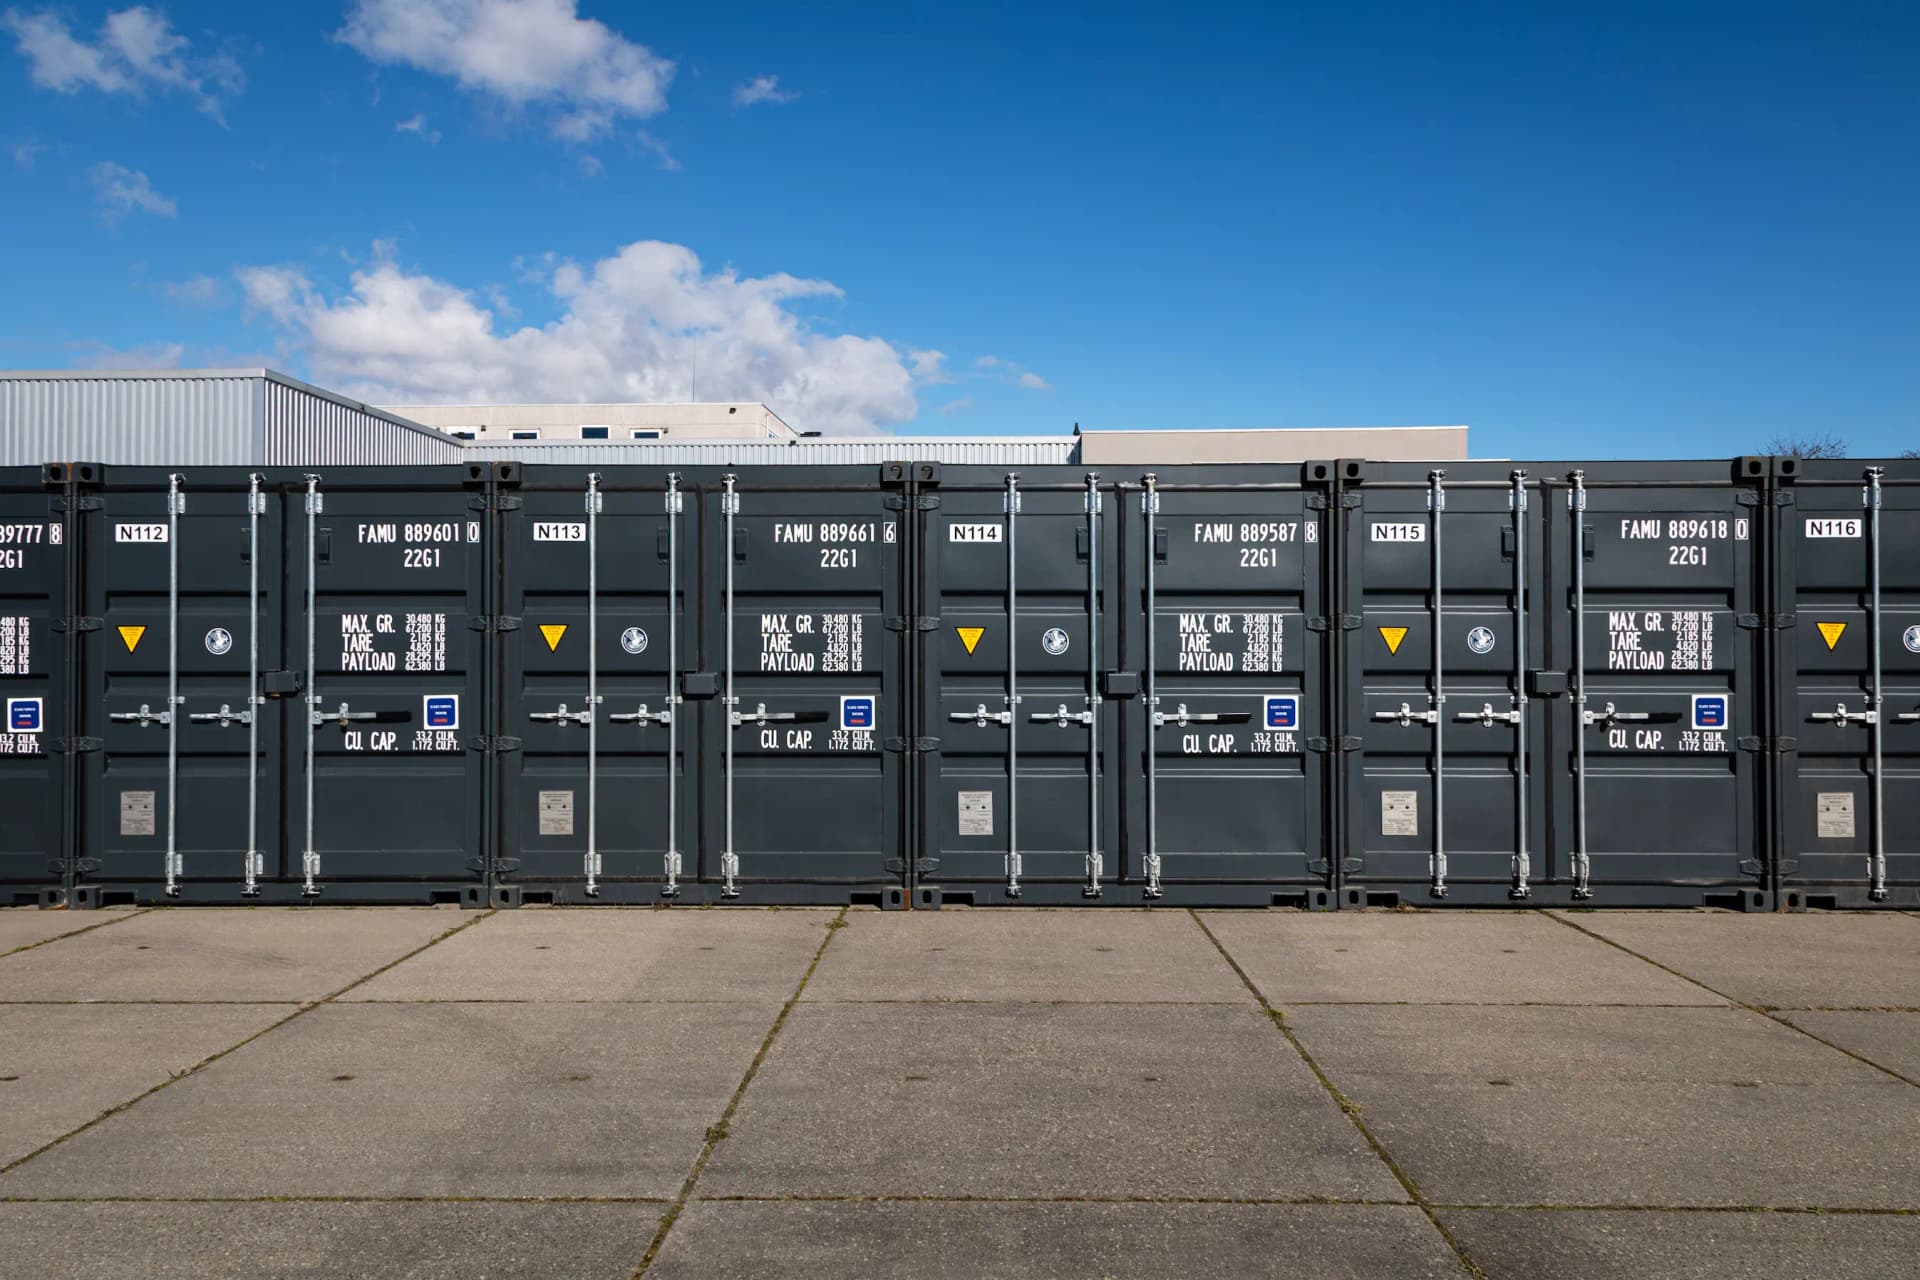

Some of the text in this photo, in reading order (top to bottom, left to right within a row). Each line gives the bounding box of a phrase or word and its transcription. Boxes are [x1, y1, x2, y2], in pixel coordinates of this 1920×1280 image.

[121, 526, 162, 540] N112
[539, 525, 580, 539] N113
[775, 523, 894, 542] FAMU 889661 6
[954, 526, 996, 540] N114
[1194, 523, 1315, 542] FAMU 889587 8
[1376, 525, 1419, 539] N115
[1621, 520, 1746, 539] FAMU 889618 0
[1811, 521, 1855, 535] N116
[52, 525, 60, 543] 8
[358, 524, 478, 543] FAMU 889601 0
[404, 549, 440, 567] 22G1
[821, 549, 856, 567] 22G1
[1240, 548, 1276, 567] 22G1
[1670, 546, 1706, 565] 22G1
[19, 617, 29, 626] KG
[405, 614, 445, 623] 30.480 KG
[822, 615, 862, 623] 30.480 KG
[1242, 615, 1283, 623] 30.480 KG
[1609, 612, 1664, 631] MAX. GR.
[1672, 612, 1712, 621] 30.480 KG
[342, 615, 395, 633] MAX. GR.
[405, 624, 445, 632] 67.200 LB
[761, 615, 814, 633] MAX. GR.
[822, 624, 862, 633] 67.200 LB
[1179, 614, 1233, 633] MAX. GR.
[1242, 624, 1283, 633] 67.200 LB
[1672, 622, 1712, 631] 67.200 LB
[19, 627, 29, 636] LB
[1702, 632, 1712, 640] KG
[19, 636, 29, 645] KG
[342, 634, 374, 651] TARE
[435, 634, 445, 642] KG
[762, 634, 792, 652] TARE
[852, 634, 862, 642] KG
[1180, 634, 1211, 652] TARE
[1272, 634, 1283, 642] KG
[1609, 632, 1642, 650] TARE
[19, 646, 29, 655] LB
[435, 643, 445, 651] LB
[852, 643, 862, 652] LB
[1272, 644, 1283, 652] LB
[1702, 641, 1712, 650] LB
[19, 655, 29, 664] KG
[435, 652, 445, 661] KG
[852, 653, 862, 661] KG
[1272, 653, 1283, 662] KG
[1609, 651, 1664, 670] PAYLOAD
[1702, 651, 1712, 660] KG
[342, 653, 396, 670] PAYLOAD
[435, 662, 445, 670] LB
[761, 653, 814, 671] PAYLOAD
[1179, 653, 1233, 671] PAYLOAD
[1702, 660, 1712, 670] LB
[19, 665, 29, 674] LB
[852, 663, 862, 671] LB
[1272, 663, 1283, 671] LB
[345, 732, 398, 751] CU. CAP.
[761, 730, 812, 749] CU. CAP.
[829, 740, 848, 749] 1.172
[1183, 735, 1237, 753] CU. CAP.
[1609, 730, 1664, 750] CU. CAP.
[412, 741, 432, 750] 1.172
[1251, 742, 1271, 752] 1.172
[1679, 741, 1699, 751] 1.172
